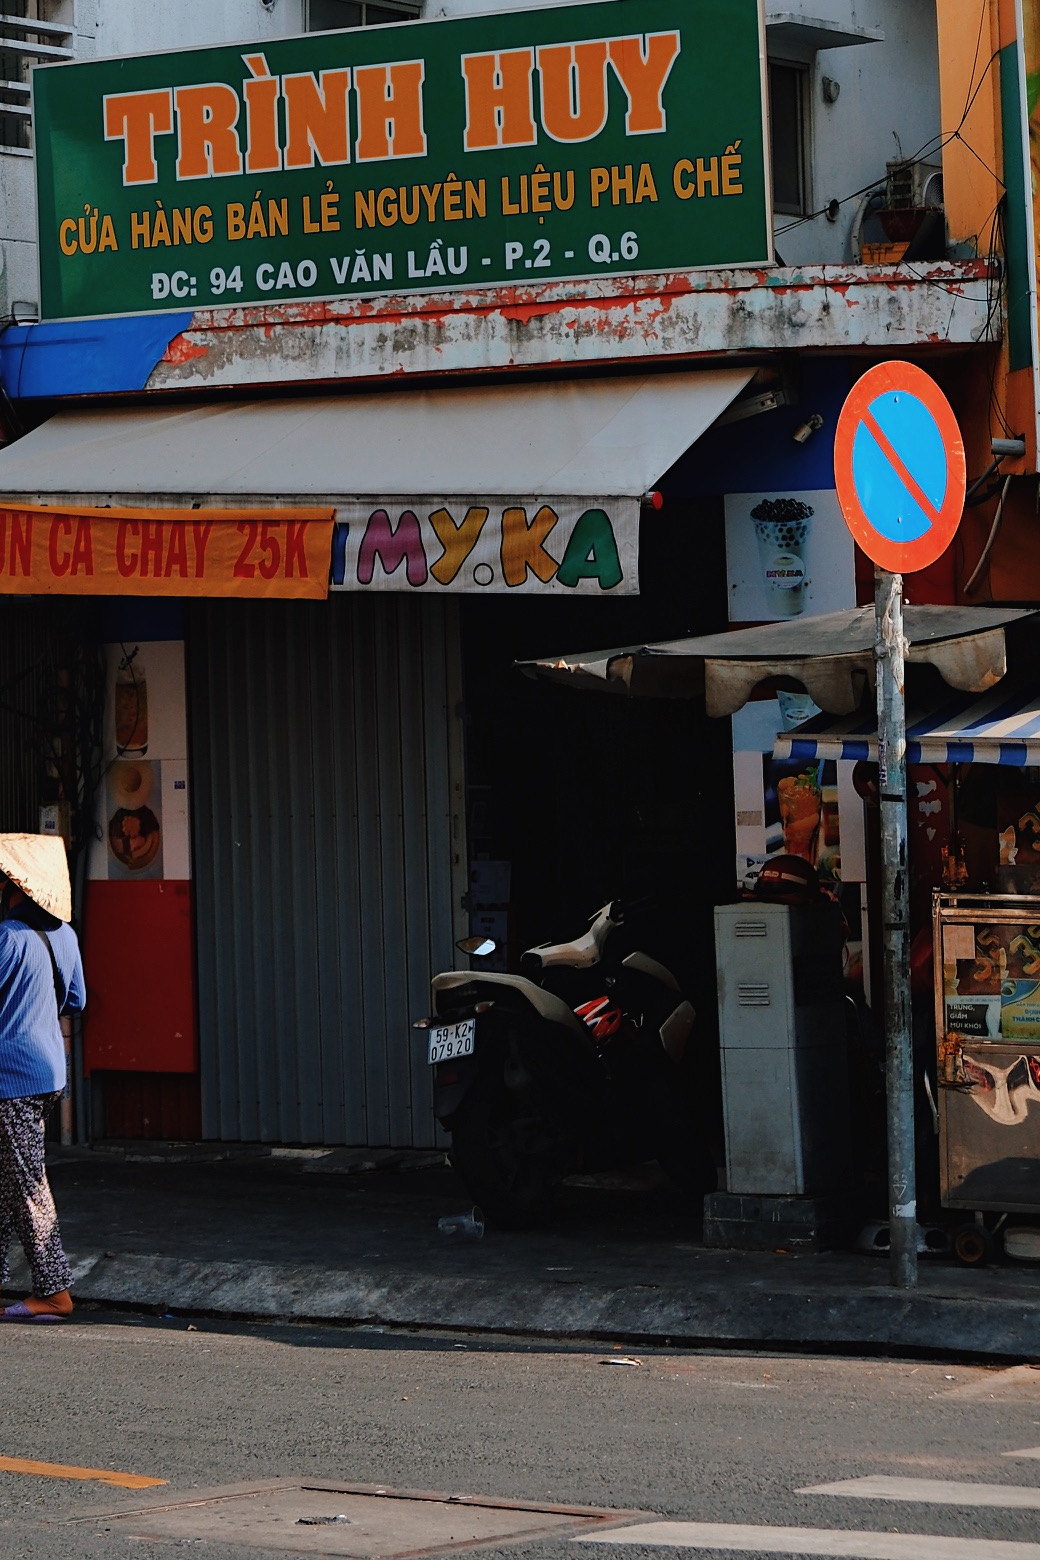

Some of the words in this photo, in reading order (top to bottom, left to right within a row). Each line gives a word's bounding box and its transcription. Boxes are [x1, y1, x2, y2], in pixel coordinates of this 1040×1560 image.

[103, 53, 428, 186] TRÌNH
[461, 30, 681, 152] HUY
[60, 200, 117, 256] CỬA
[130, 192, 214, 250] HÀNG
[227, 189, 289, 242] BÁN
[302, 180, 341, 235] LẺ
[354, 171, 487, 228] NGUYÊN
[502, 163, 575, 226] LIỆU
[591, 161, 659, 208] PHA
[673, 140, 743, 201] CHẾ
[151, 270, 198, 301] ĐC:
[210, 264, 244, 294] 94
[256, 259, 319, 293] CAO
[330, 248, 389, 287] VĂN
[407, 239, 469, 280] LẦU
[505, 239, 552, 271] P.2
[588, 231, 640, 266] Q.6
[116, 517, 213, 580] CHAY
[233, 519, 311, 581] 25K
[359, 505, 625, 590] MY.KA
[431, 1038, 471, 1061] 079.20
[436, 1023, 468, 1043] 59-K2
